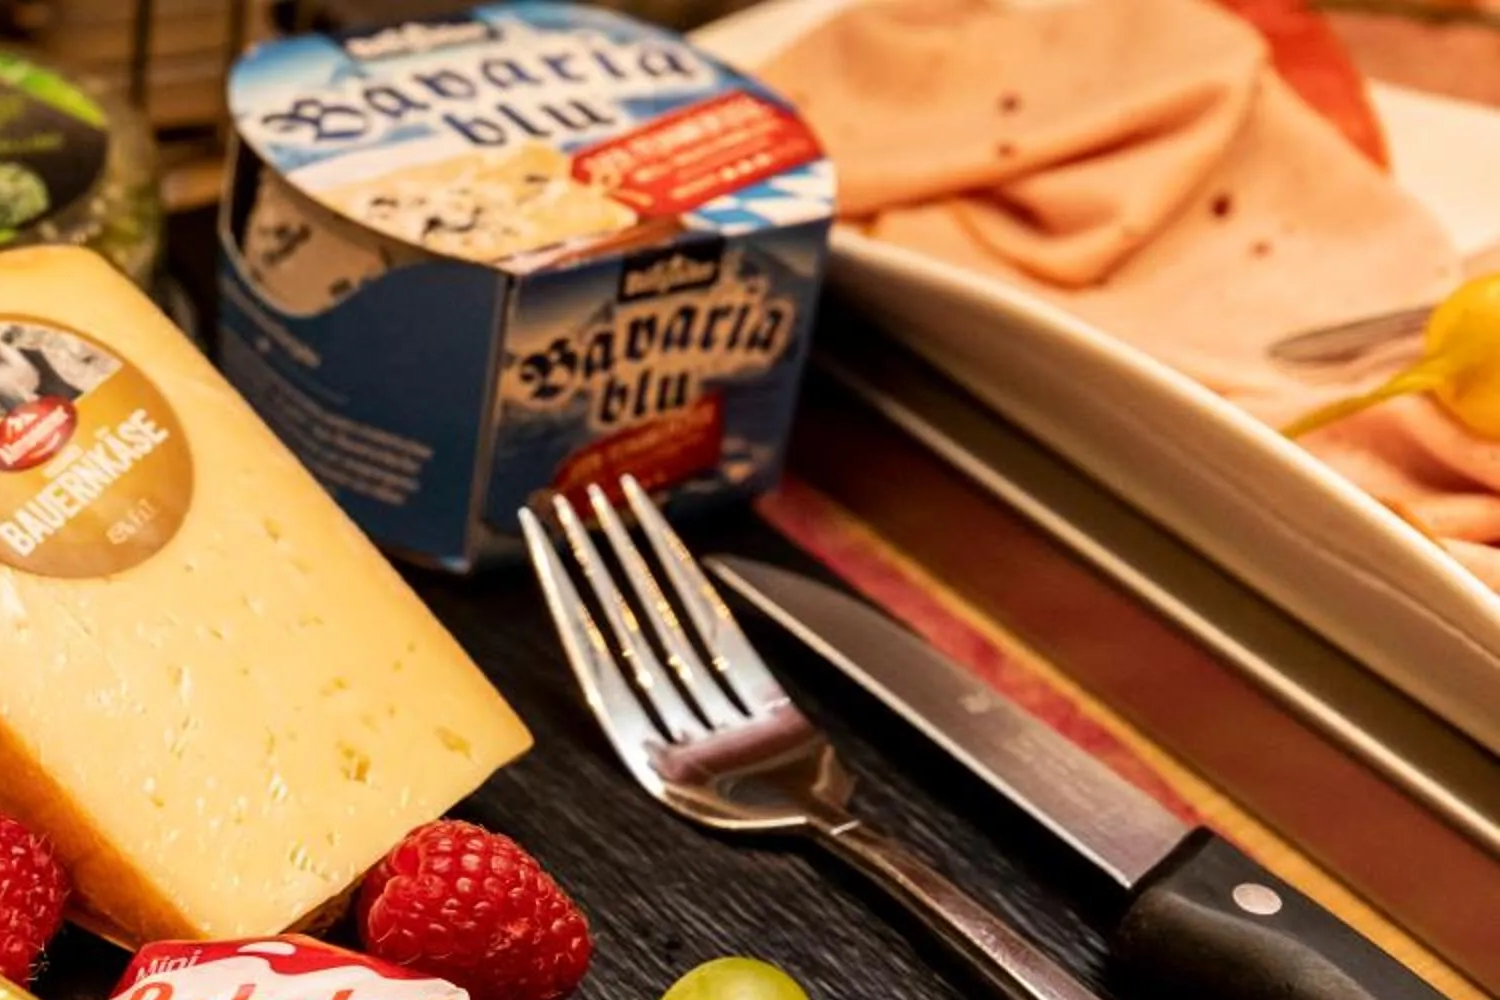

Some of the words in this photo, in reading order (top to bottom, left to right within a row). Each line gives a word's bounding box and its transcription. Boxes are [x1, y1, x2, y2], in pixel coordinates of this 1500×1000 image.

[263, 43, 696, 142] Bavaria
[444, 97, 616, 147] blu
[519, 280, 784, 399] Bavaria
[597, 370, 689, 422] blu
[134, 949, 203, 984] Mini
